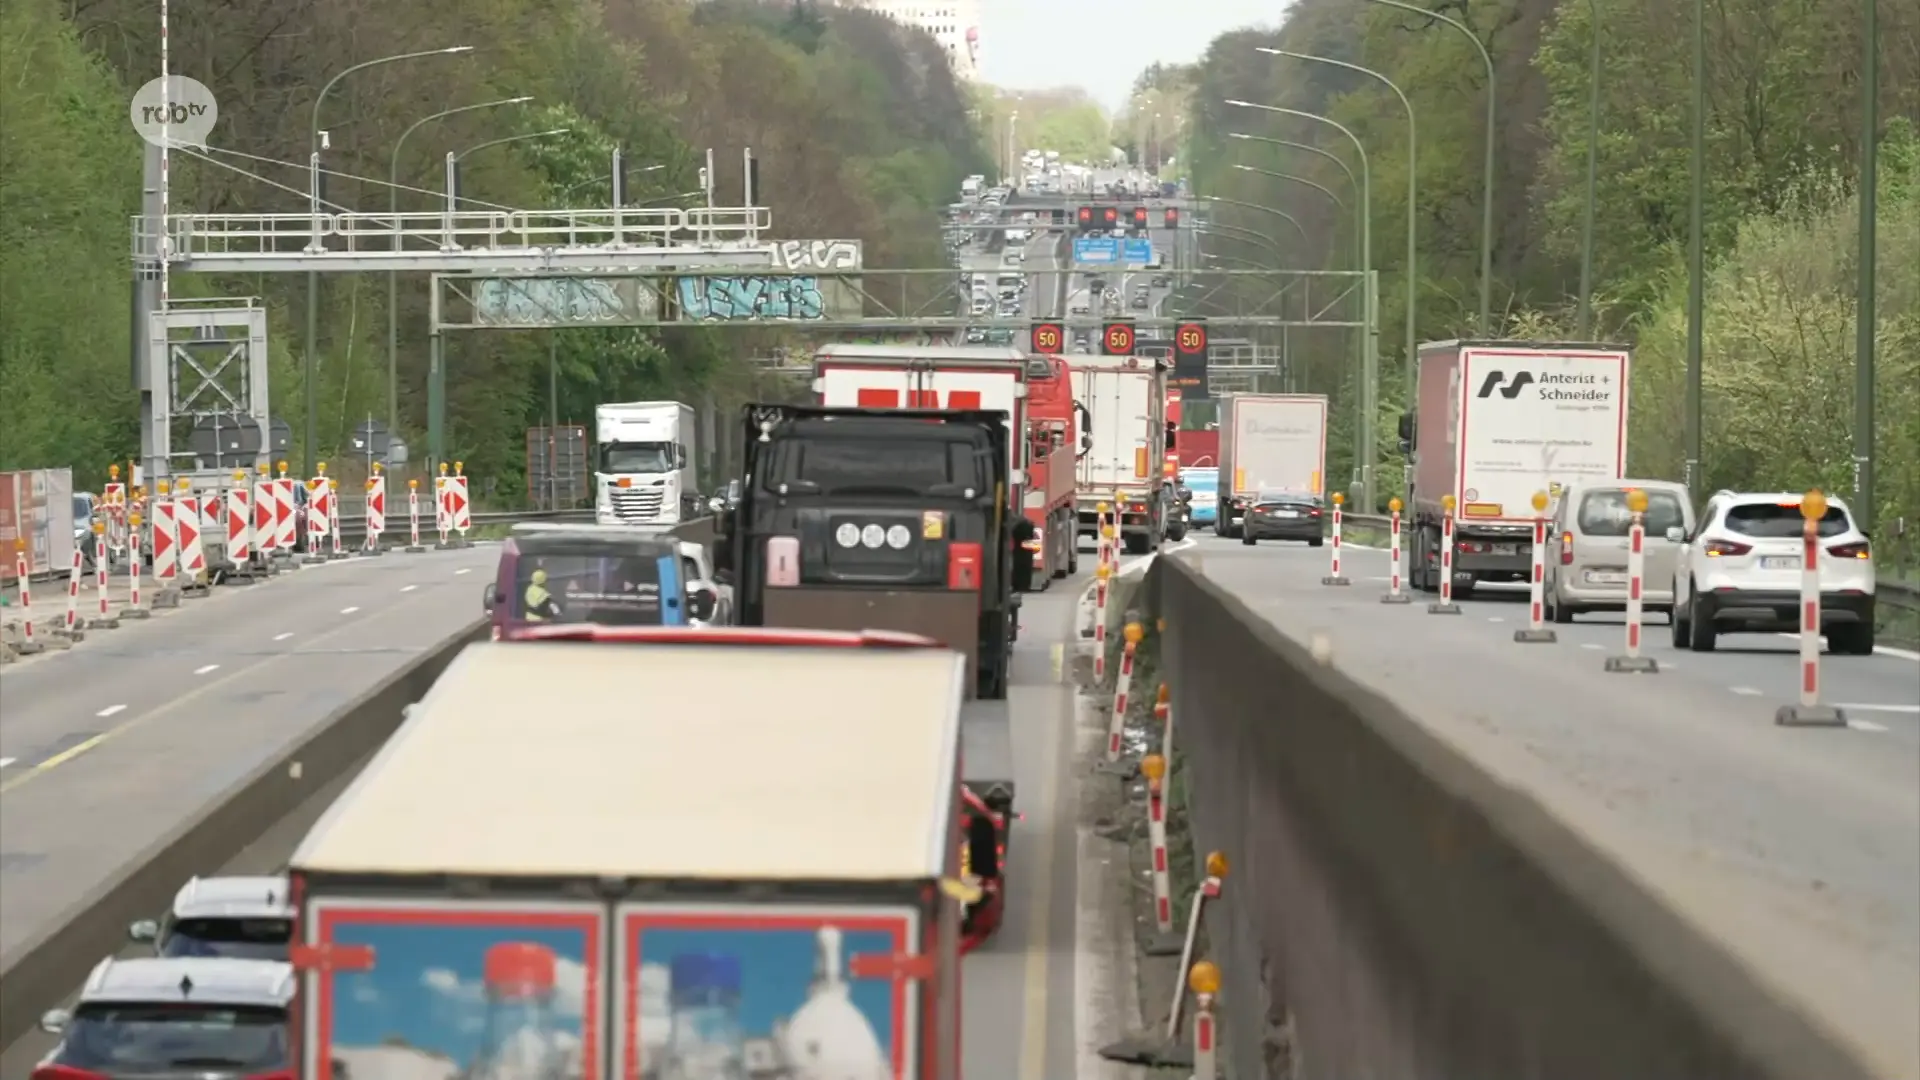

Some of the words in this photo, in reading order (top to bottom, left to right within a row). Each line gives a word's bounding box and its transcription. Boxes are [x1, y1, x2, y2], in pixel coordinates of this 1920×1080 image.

[1039, 332, 1055, 346] 50
[1110, 332, 1127, 346] 50
[1182, 332, 1199, 346] 50
[1539, 371, 1596, 384] Anterist
[1539, 387, 1611, 401] Schneider
